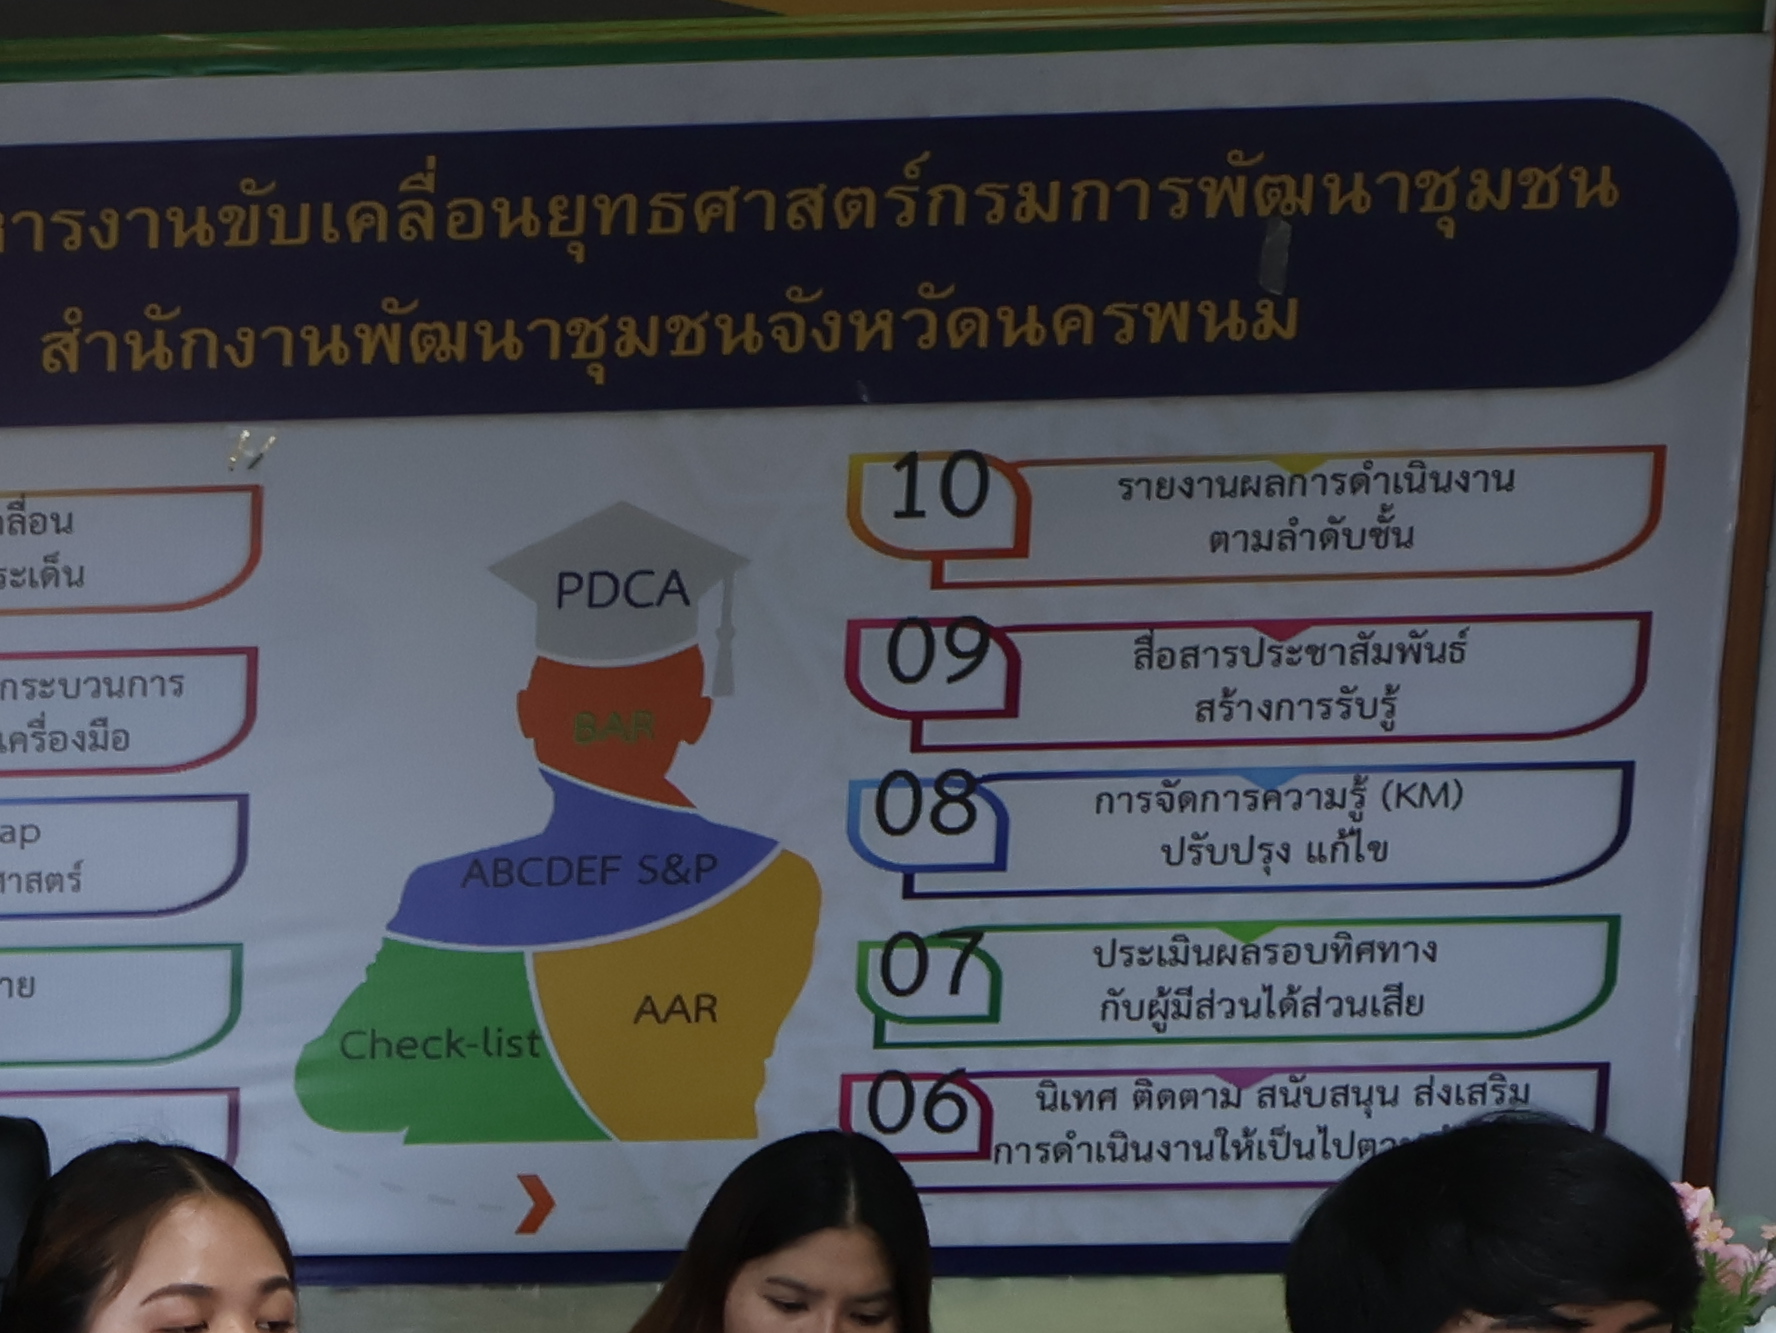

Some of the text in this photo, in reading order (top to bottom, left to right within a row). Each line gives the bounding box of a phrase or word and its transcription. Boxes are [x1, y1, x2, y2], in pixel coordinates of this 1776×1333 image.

[40, 282, 1299, 384] สำนักงานพัฒนาชุมชนจังหวัดนครพนม
[892, 449, 991, 519] 10
[1117, 464, 1516, 503] รายงานผลการดำเนินงาน
[1208, 503, 1415, 554] ตามลำดับชั้น
[556, 569, 691, 609] PDCA
[887, 615, 991, 685] 09
[1134, 626, 1470, 673] สื่อสารประชาสัมพันธ์
[574, 712, 654, 743] BAR
[1194, 683, 1399, 731] สร้างการรับรู้
[875, 768, 979, 837] 08
[1094, 778, 1464, 825] การจัดการความรู้ (KM)
[461, 854, 718, 888] ABCDEF S&P
[1162, 827, 1389, 875] ปรับปรุง แก้ไข
[879, 931, 984, 997] 07
[1093, 933, 1438, 970] ประเมินผลรอบทิศทาง
[633, 994, 718, 1025] AAR
[1100, 982, 1426, 1034] กับผู้มีส่วนได้ส่วนเสีย
[339, 1028, 541, 1062] Check-list
[868, 1068, 971, 1135] 06
[1035, 1080, 1118, 1113] นิเทศ
[1133, 1079, 1243, 1112] ติดตาม
[1257, 1075, 1399, 1121] สนับสนุน
